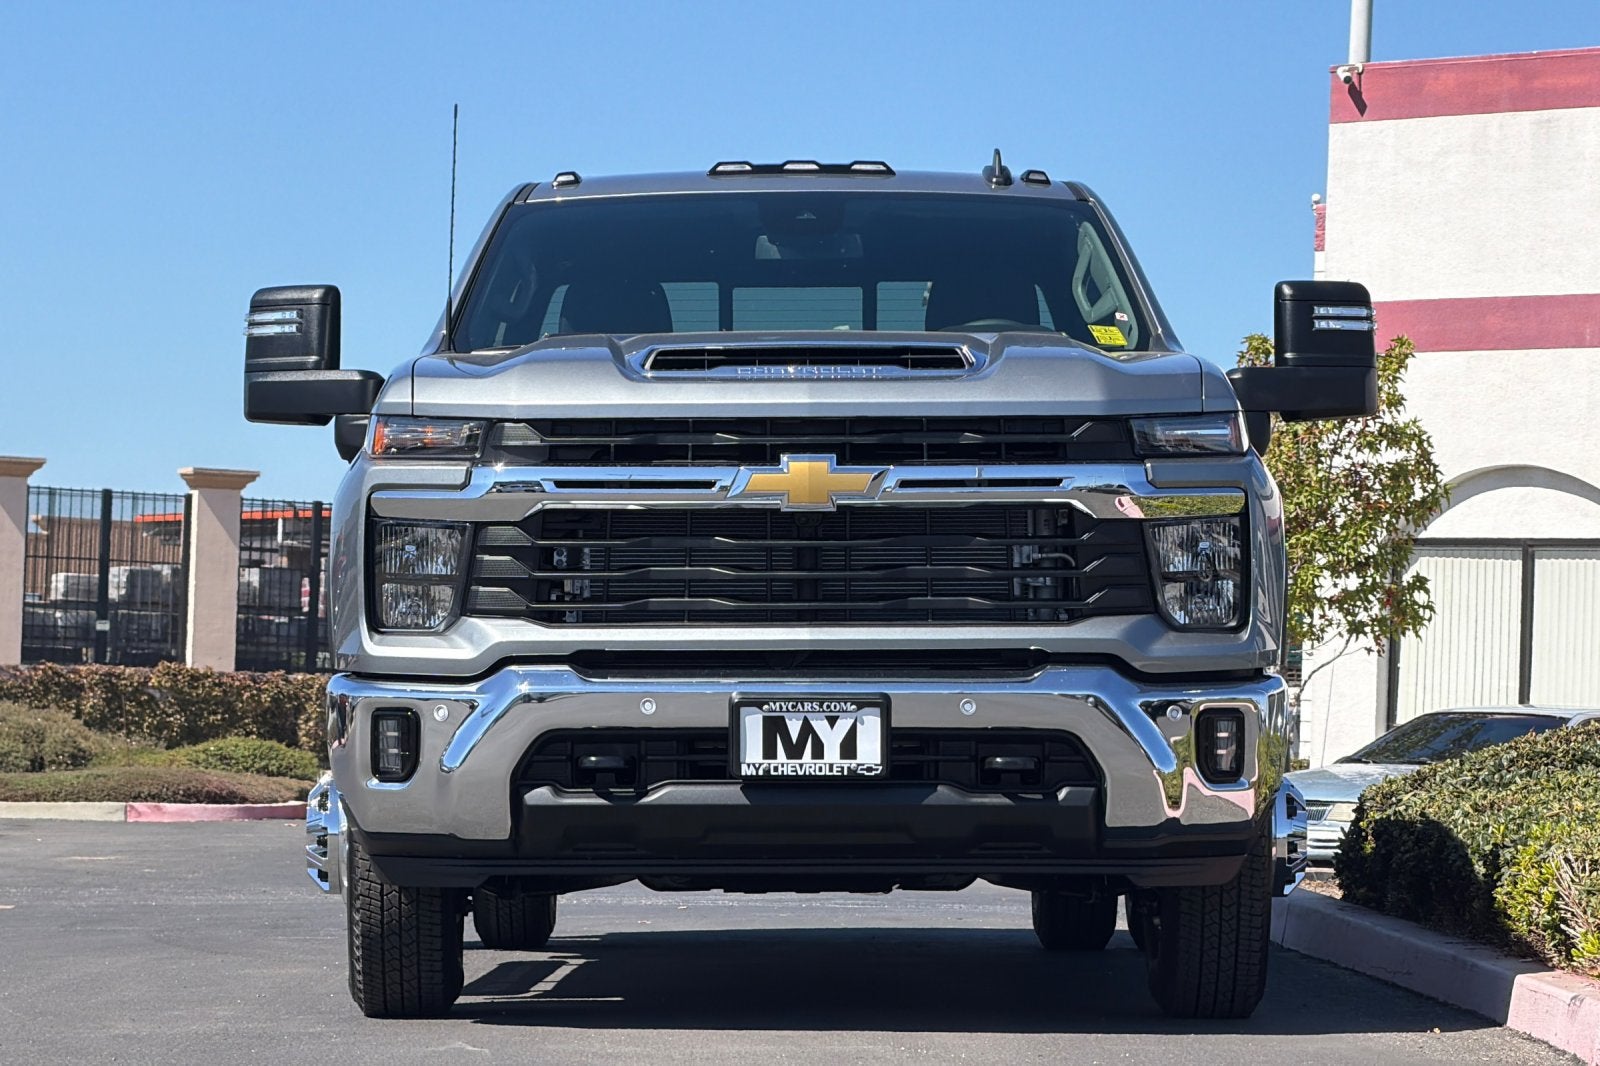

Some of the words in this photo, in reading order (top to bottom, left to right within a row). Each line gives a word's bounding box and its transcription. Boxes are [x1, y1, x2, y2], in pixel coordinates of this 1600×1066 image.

[768, 702, 852, 712] MYCARS.COM
[762, 715, 858, 760] MY
[741, 763, 768, 776] MY
[770, 763, 850, 775] CHEVROLET
